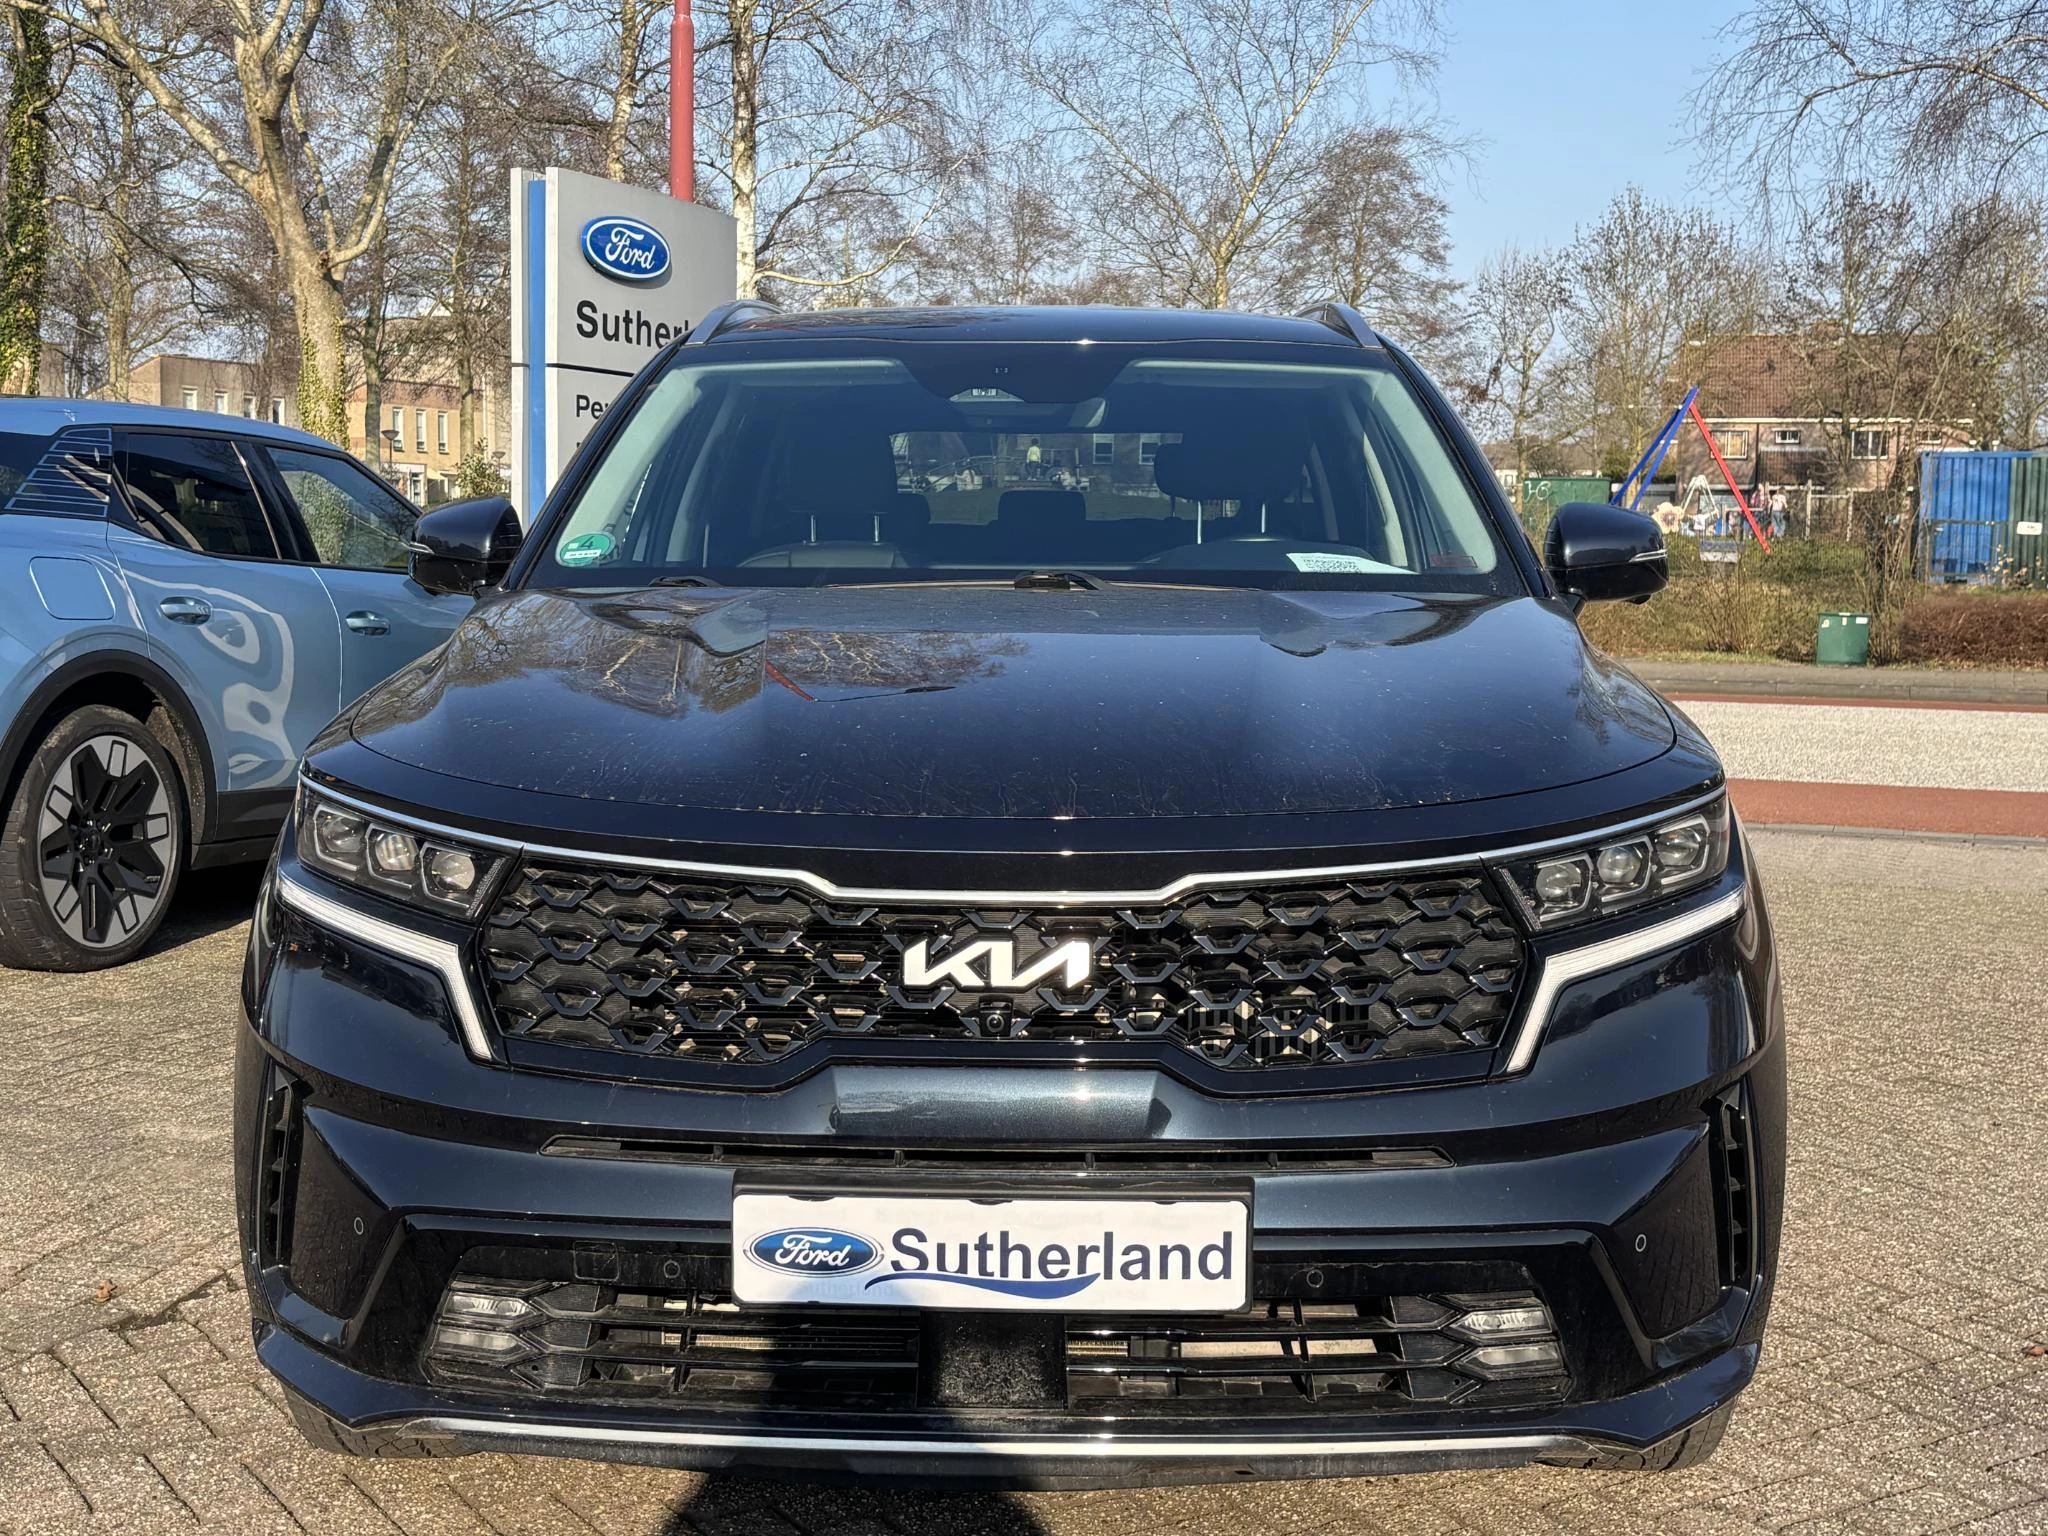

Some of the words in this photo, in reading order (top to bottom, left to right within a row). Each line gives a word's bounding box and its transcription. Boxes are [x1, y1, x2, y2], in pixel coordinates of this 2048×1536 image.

[605, 227, 656, 269] Ford
[576, 394, 609, 420] Pe
[904, 939, 1090, 988] KIA
[774, 1234, 850, 1267] Ford
[891, 1227, 1233, 1281] Sutherland
